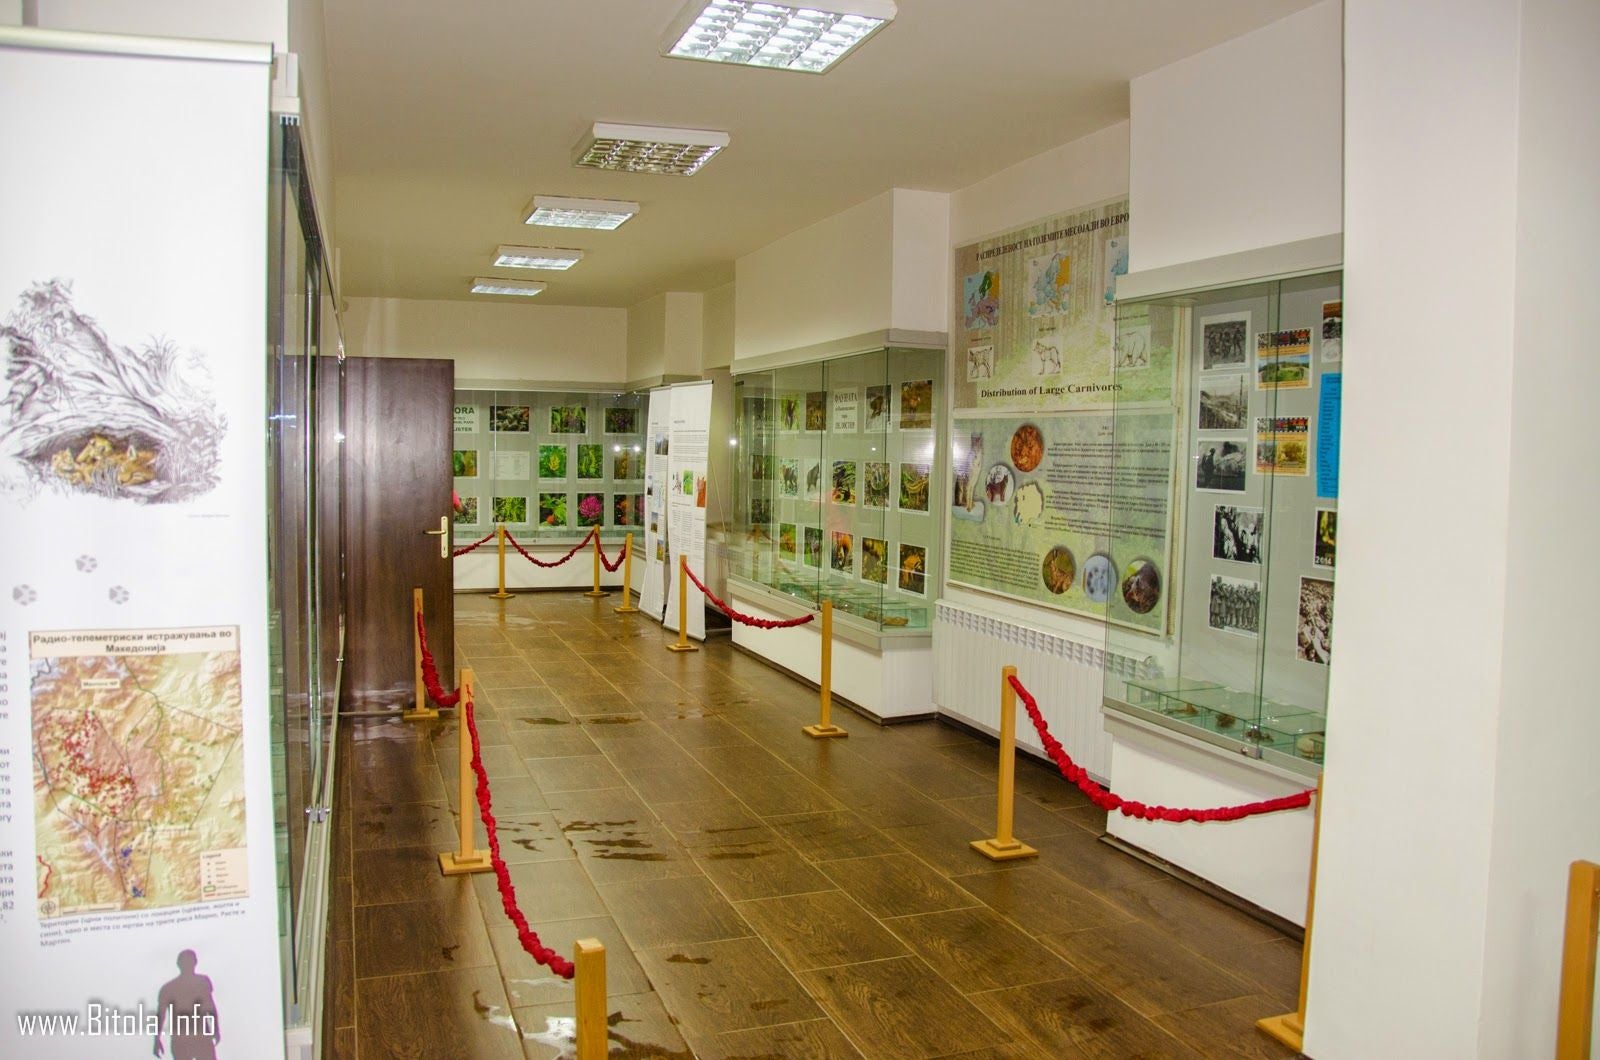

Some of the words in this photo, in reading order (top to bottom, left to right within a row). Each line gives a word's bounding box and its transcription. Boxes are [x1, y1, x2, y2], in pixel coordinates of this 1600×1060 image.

[981, 387, 1027, 398] Distribution
[1028, 386, 1037, 395] of
[1039, 386, 1065, 396] Large
[1068, 383, 1123, 394] Carnivores
[33, 633, 143, 645] Радио-телеметриски
[146, 631, 217, 642] истражувања
[219, 630, 232, 638] во
[105, 643, 166, 654] Македонија
